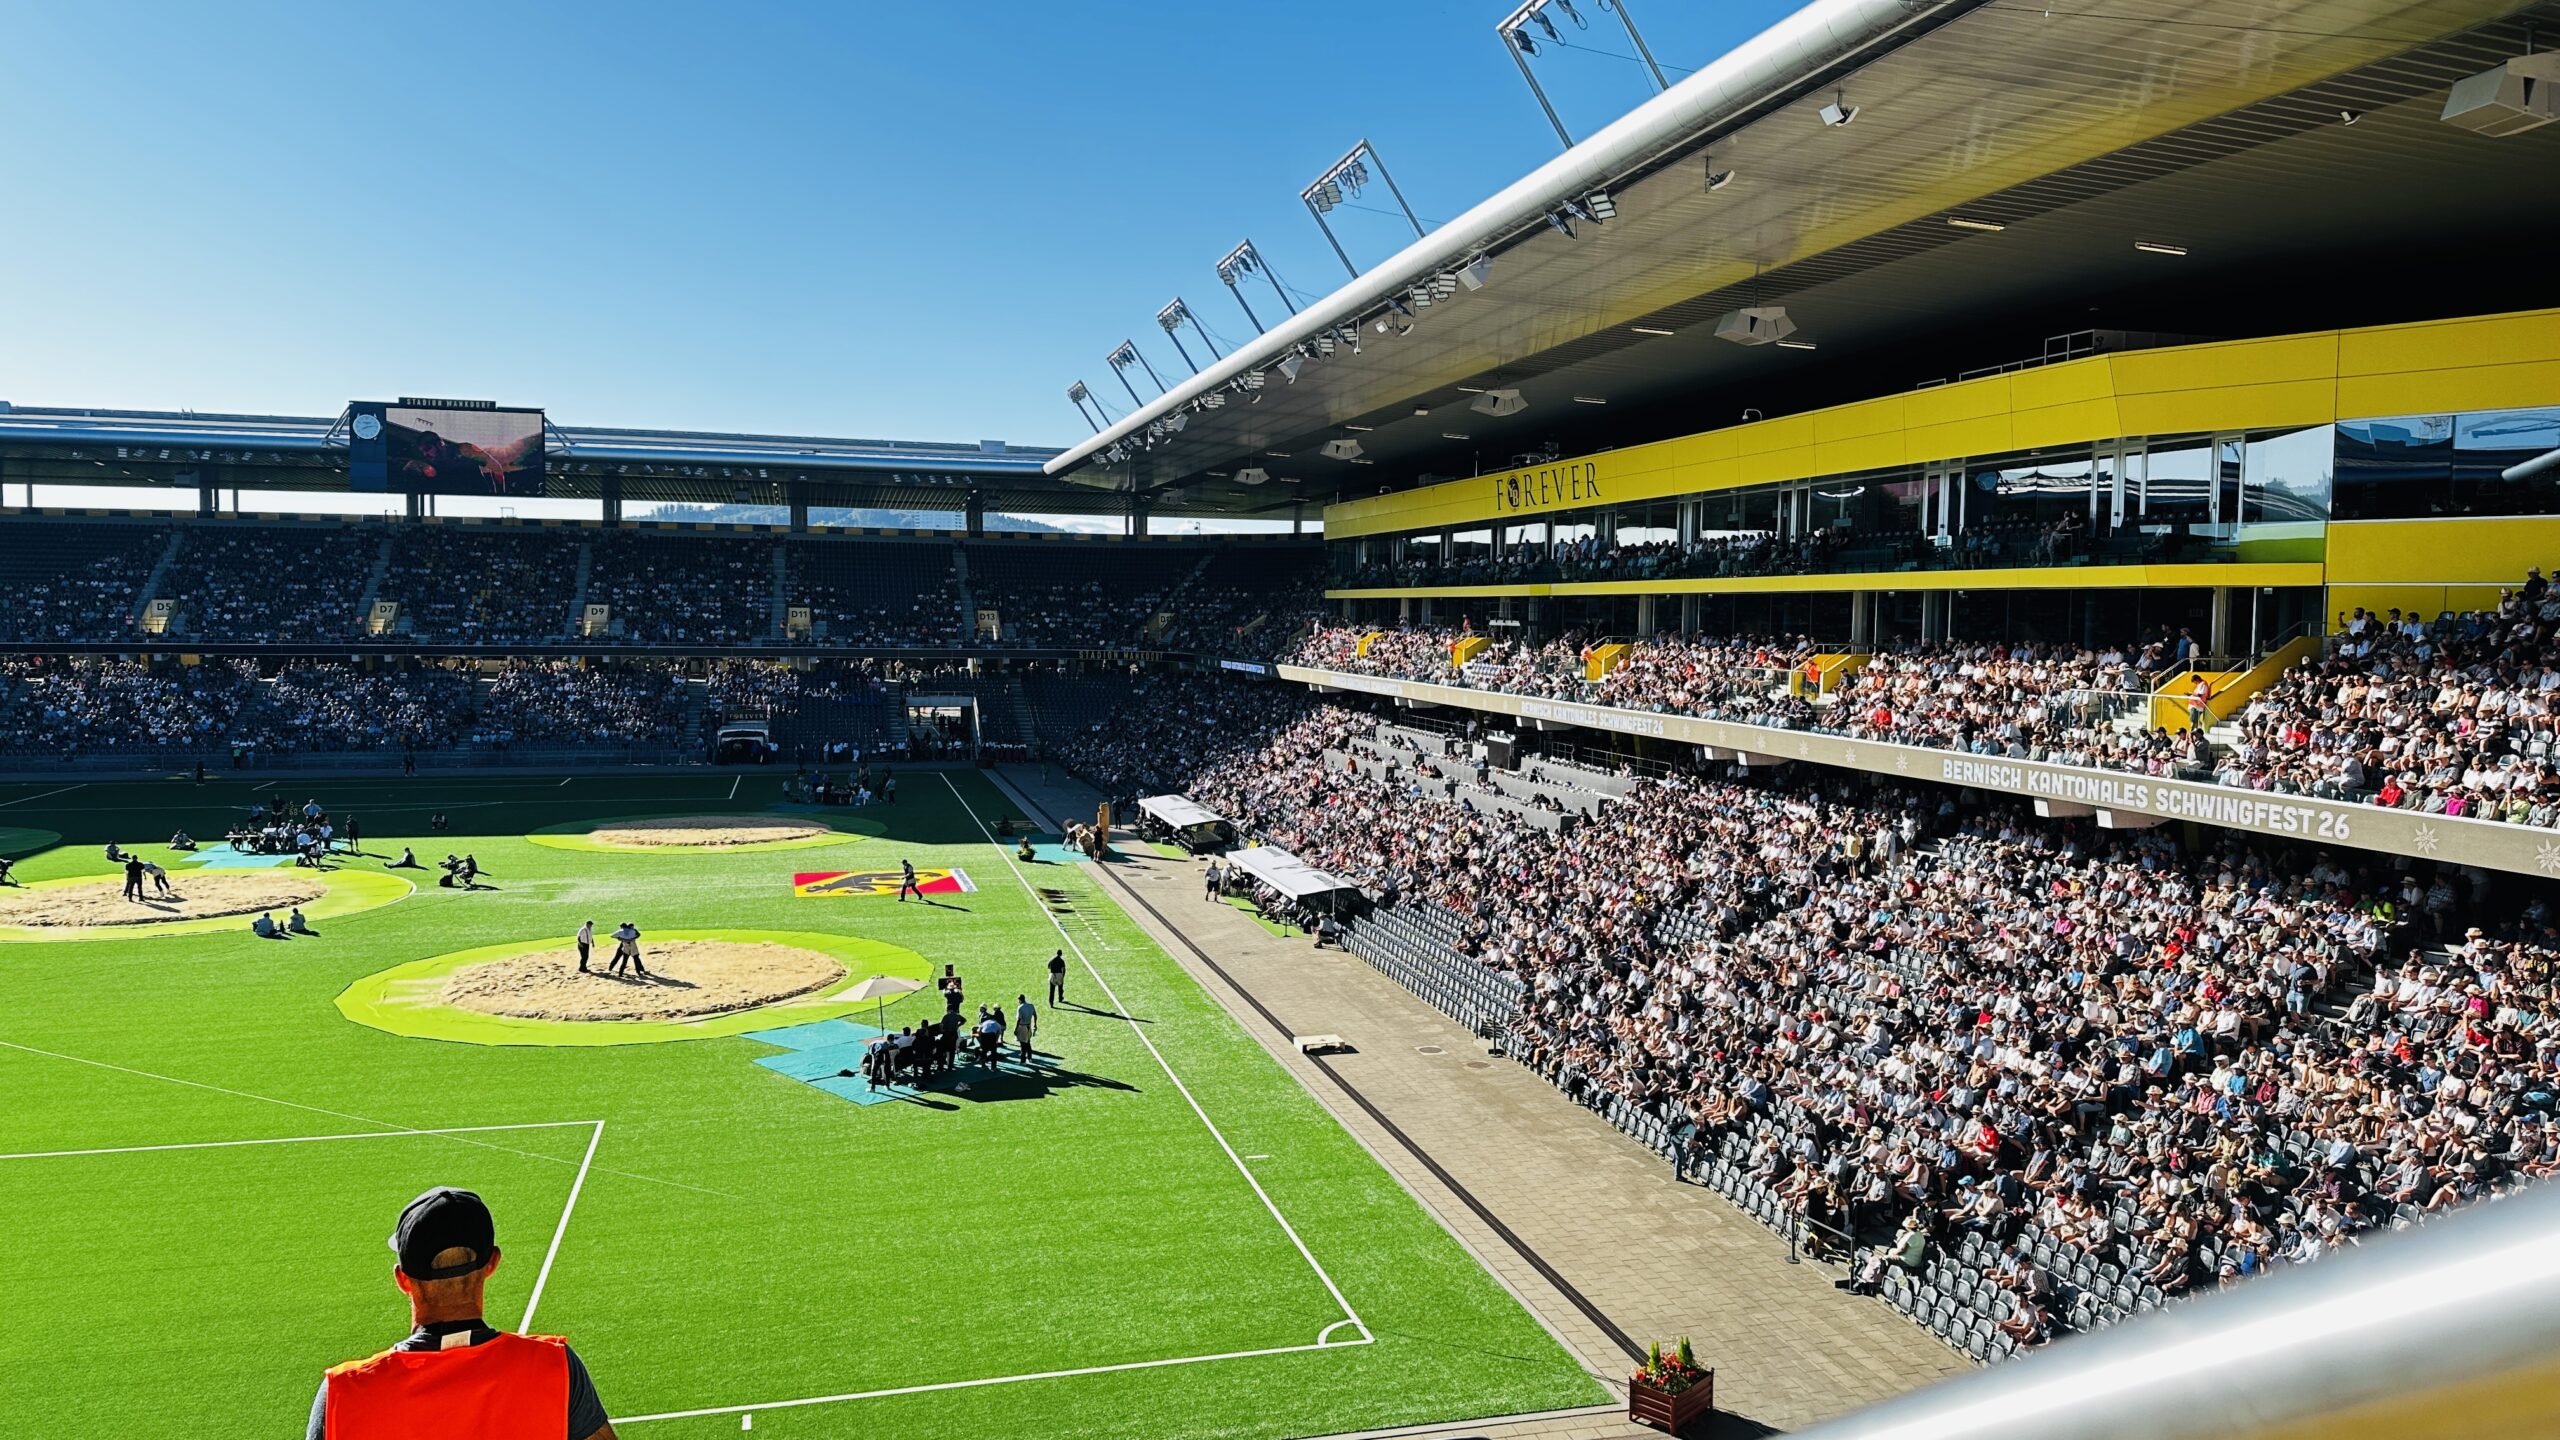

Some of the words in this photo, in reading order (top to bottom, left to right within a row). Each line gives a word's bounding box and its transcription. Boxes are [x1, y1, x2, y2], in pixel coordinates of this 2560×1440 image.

[406, 398, 442, 407] STADION
[1496, 462, 1601, 512] FOREVER
[156, 602, 171, 611] D5
[380, 605, 394, 613] D7
[591, 607, 605, 616] D9
[791, 610, 808, 618] D11
[979, 613, 996, 621] D13
[1079, 651, 1118, 660] STADION
[1520, 701, 1552, 719] BERNISCH
[1555, 705, 1597, 725] KANTONALES
[1599, 712, 1652, 734] SCHWINGFEST
[1653, 720, 1664, 736] 26
[1942, 758, 2021, 789] BERNISCH
[2027, 771, 2149, 809] KANTONALES
[2155, 788, 2315, 834] SCHWINGFEST
[2317, 810, 2351, 841] 26
